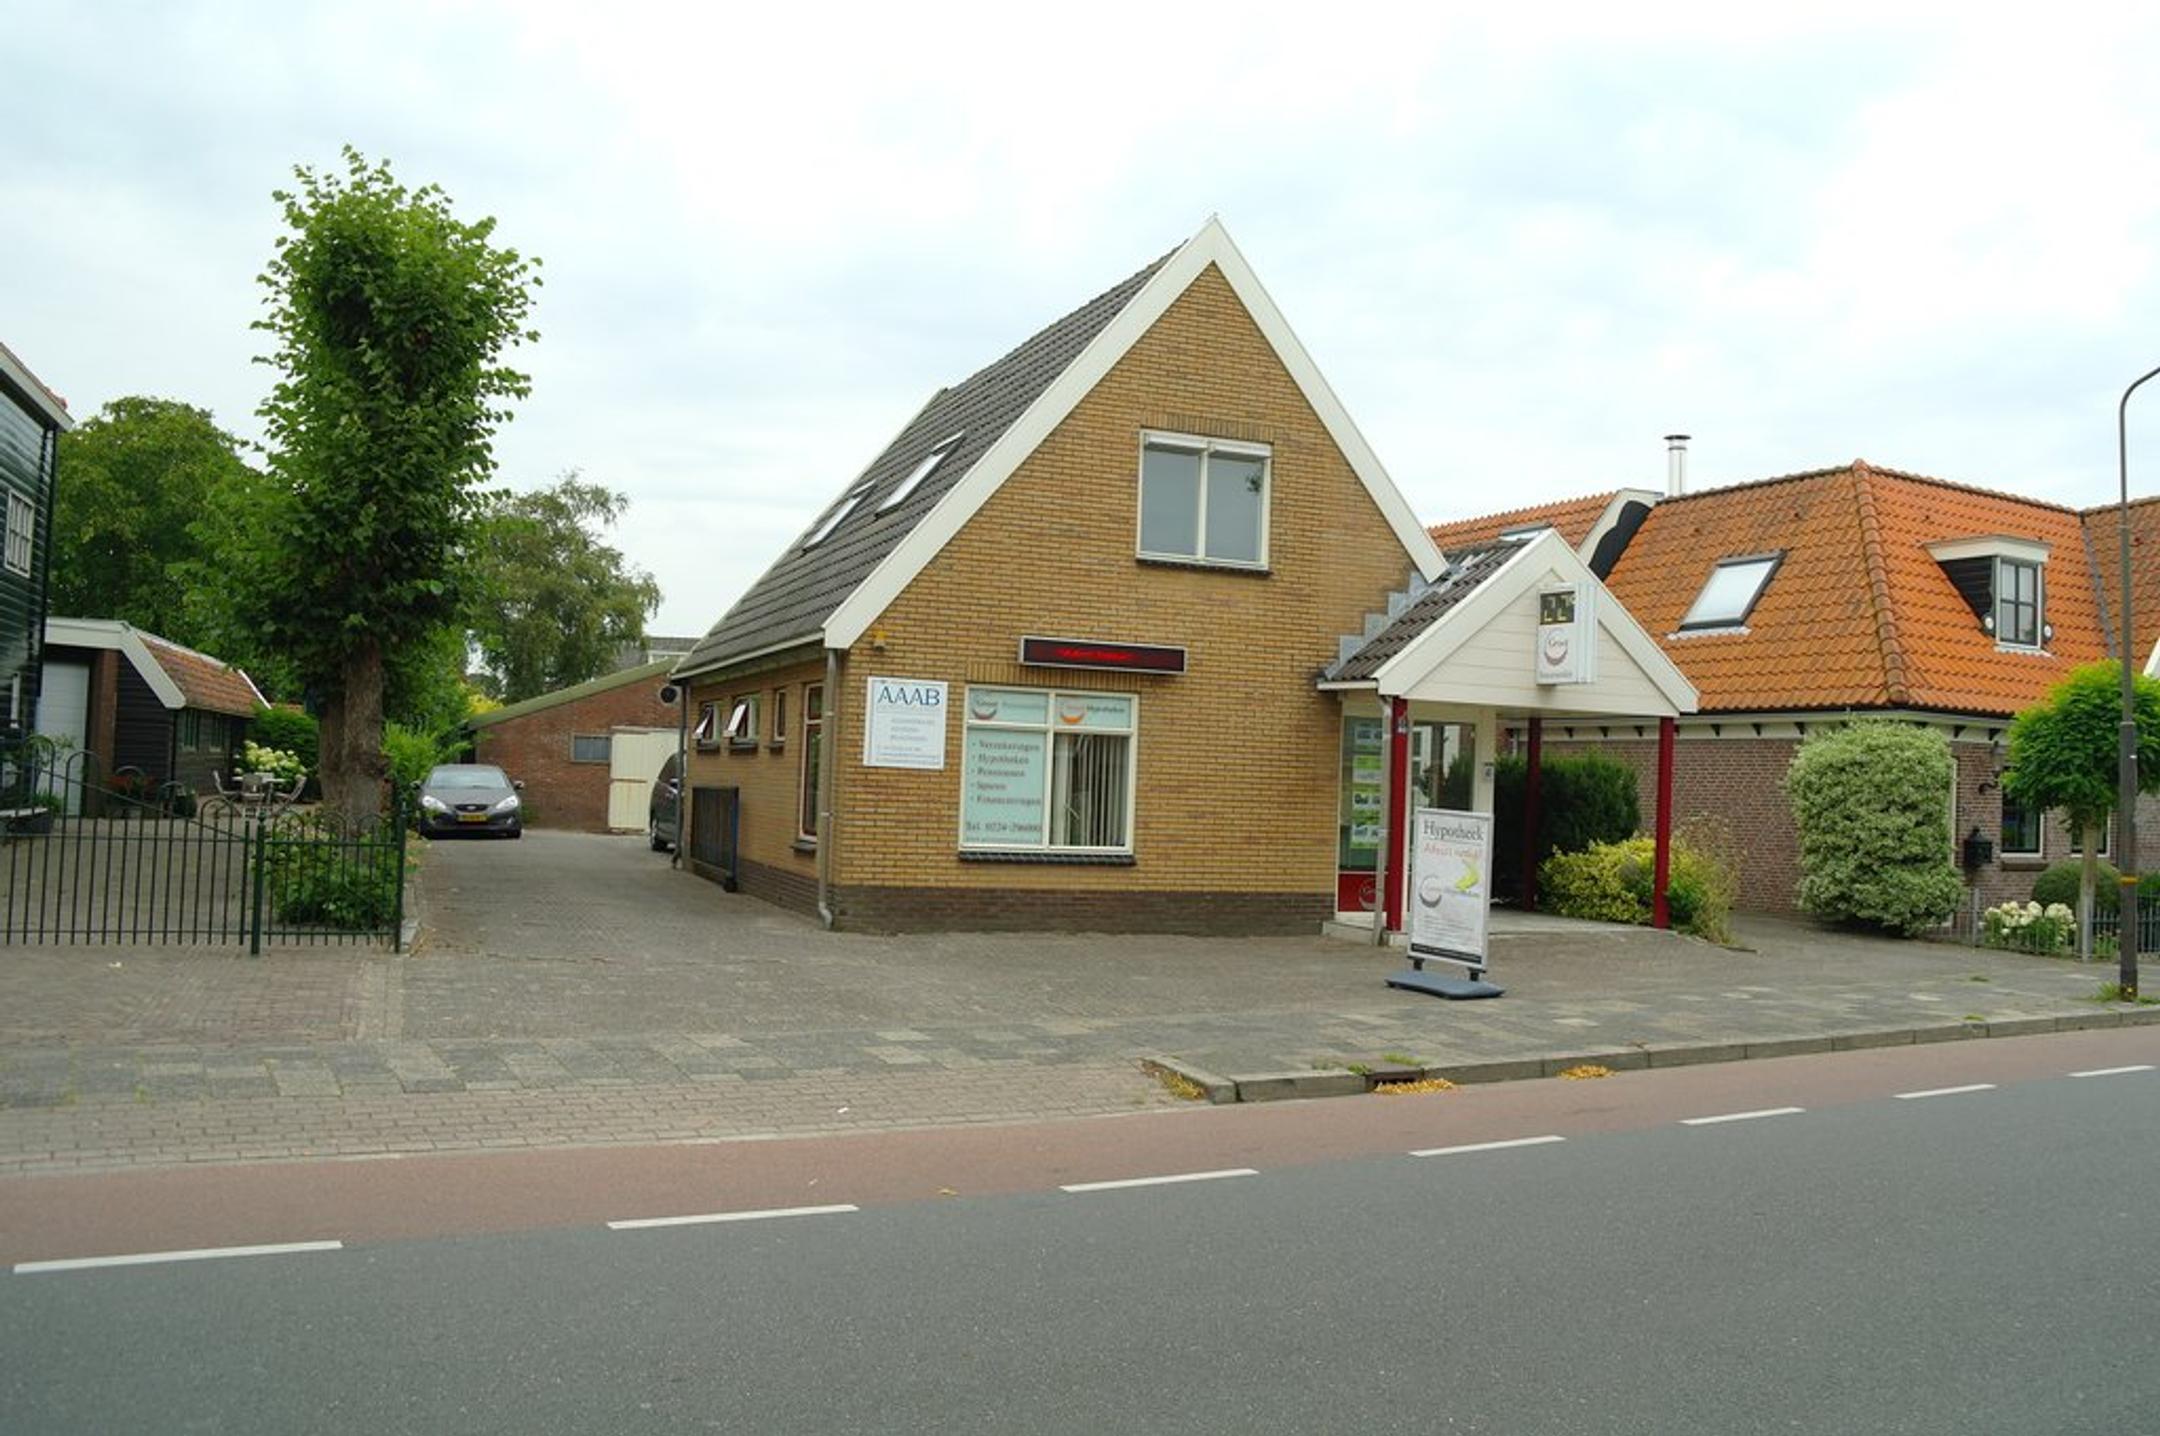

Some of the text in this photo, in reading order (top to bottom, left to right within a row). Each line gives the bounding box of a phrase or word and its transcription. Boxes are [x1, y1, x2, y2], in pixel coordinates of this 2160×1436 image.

[877, 685, 941, 706] AAAB
[977, 752, 1030, 765] Hypotheken
[1423, 818, 1484, 841] Hypotheek
